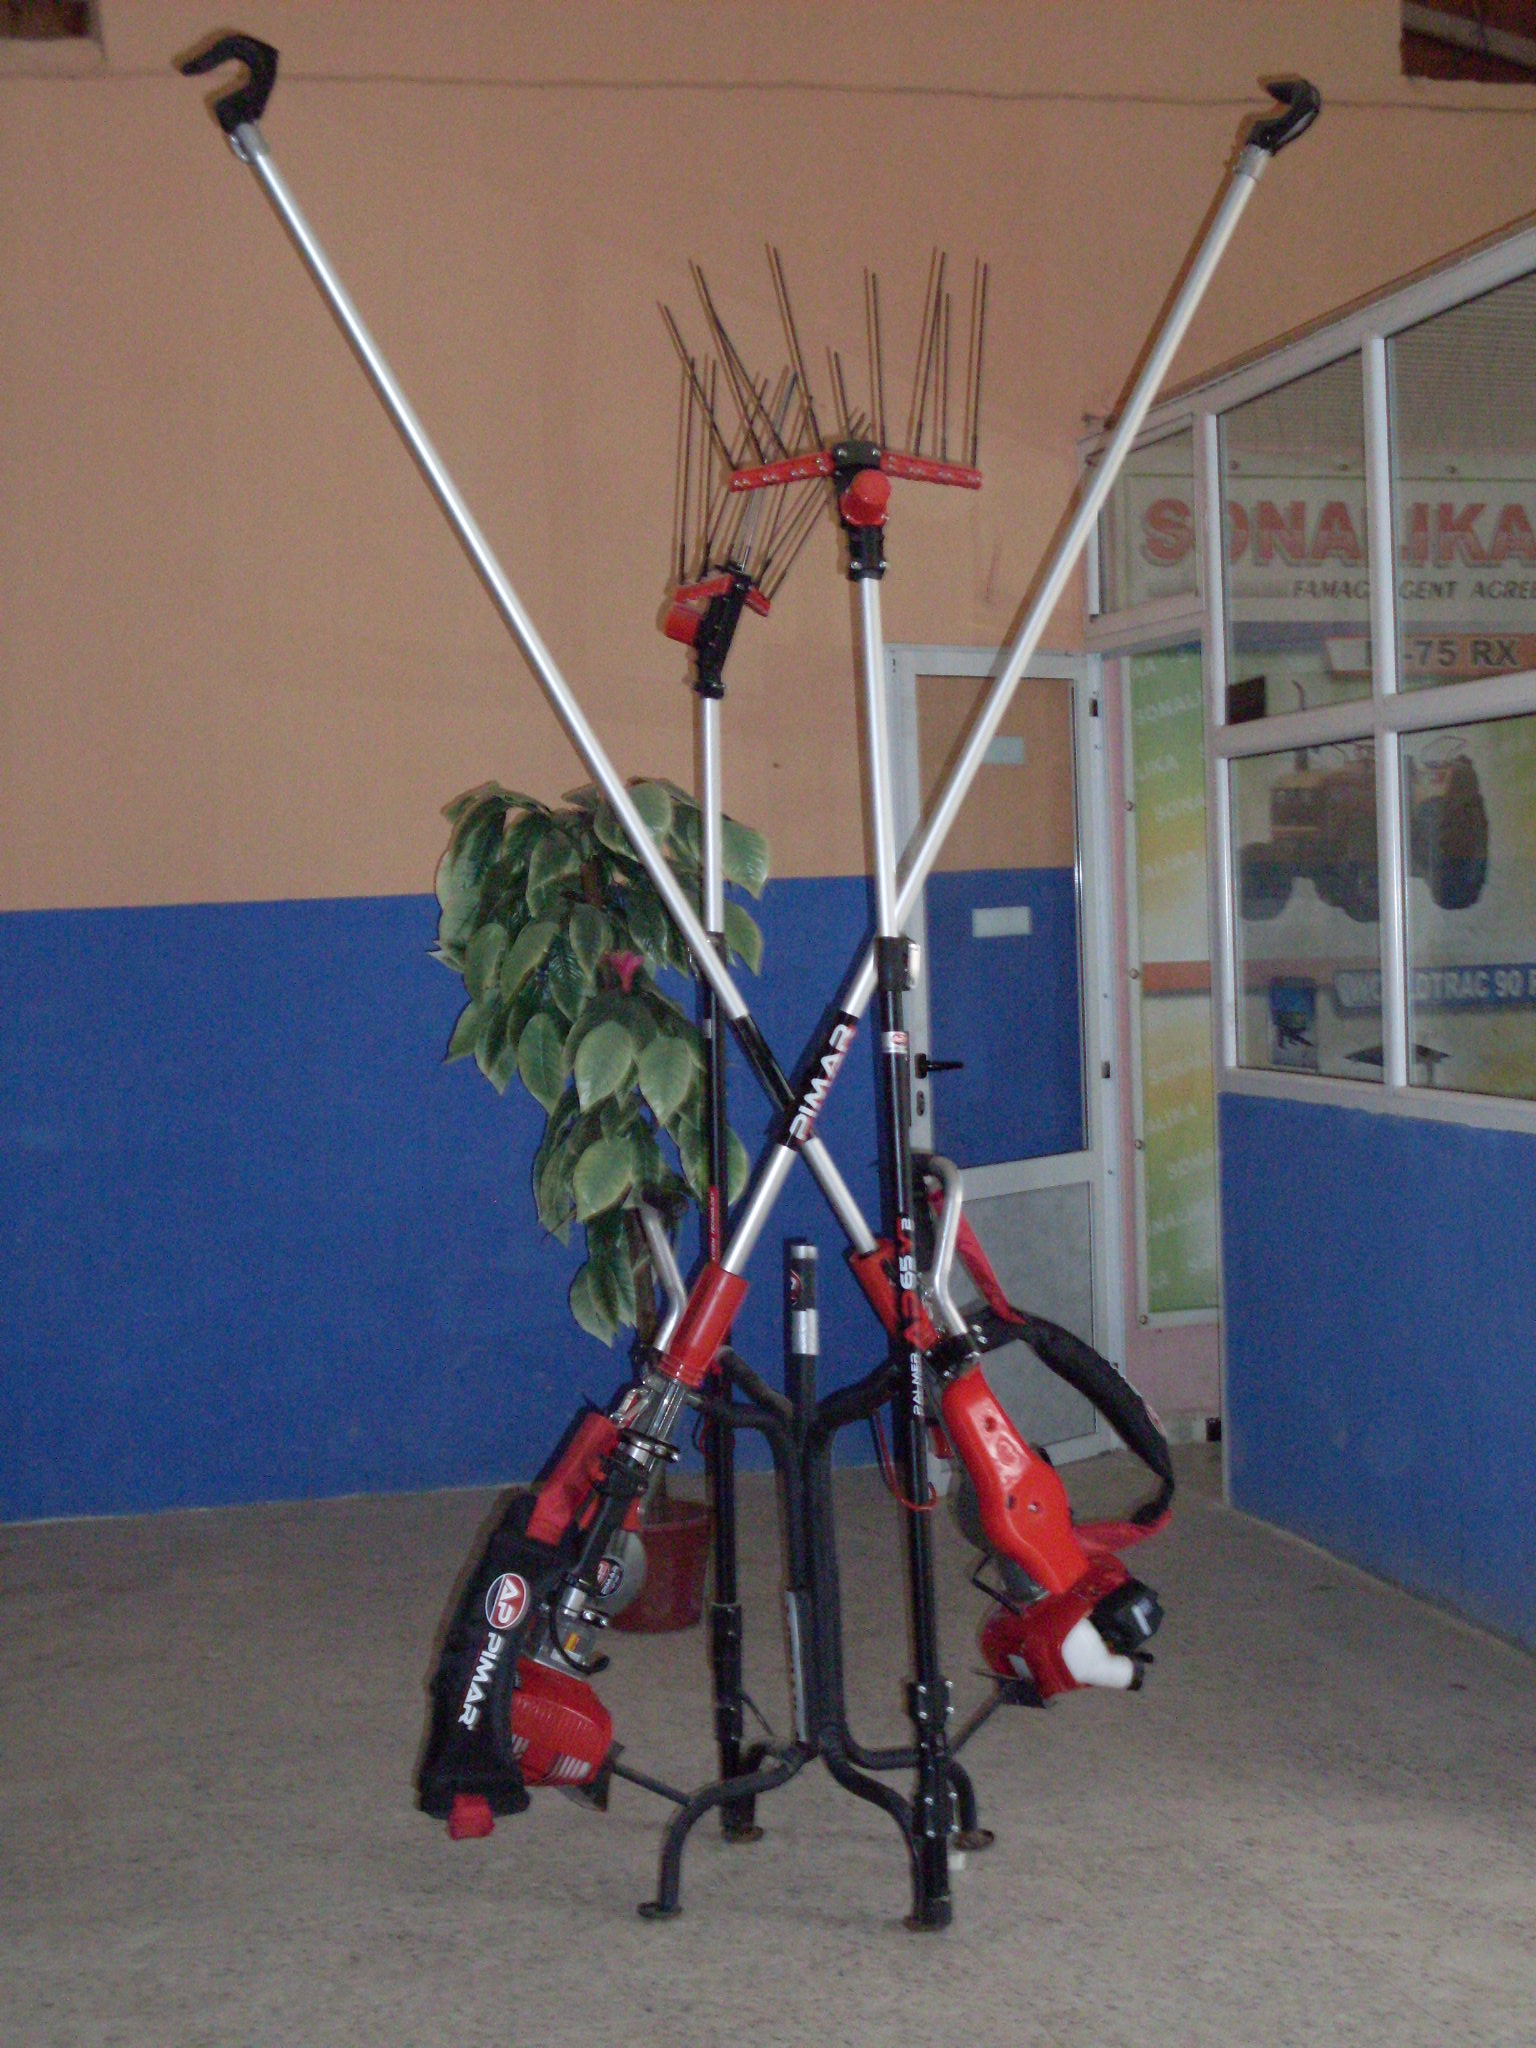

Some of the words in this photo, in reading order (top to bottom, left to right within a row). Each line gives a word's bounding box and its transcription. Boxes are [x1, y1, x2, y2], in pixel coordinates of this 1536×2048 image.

[1143, 499, 1536, 563] SNAIKA
[1401, 580, 1457, 600] GENT
[1471, 639, 1518, 666] RX
[899, 1255, 916, 1290] 65
[910, 1352, 925, 1417] PALMER
[498, 1579, 521, 1624] AP
[459, 1632, 502, 1730] PIMAR
